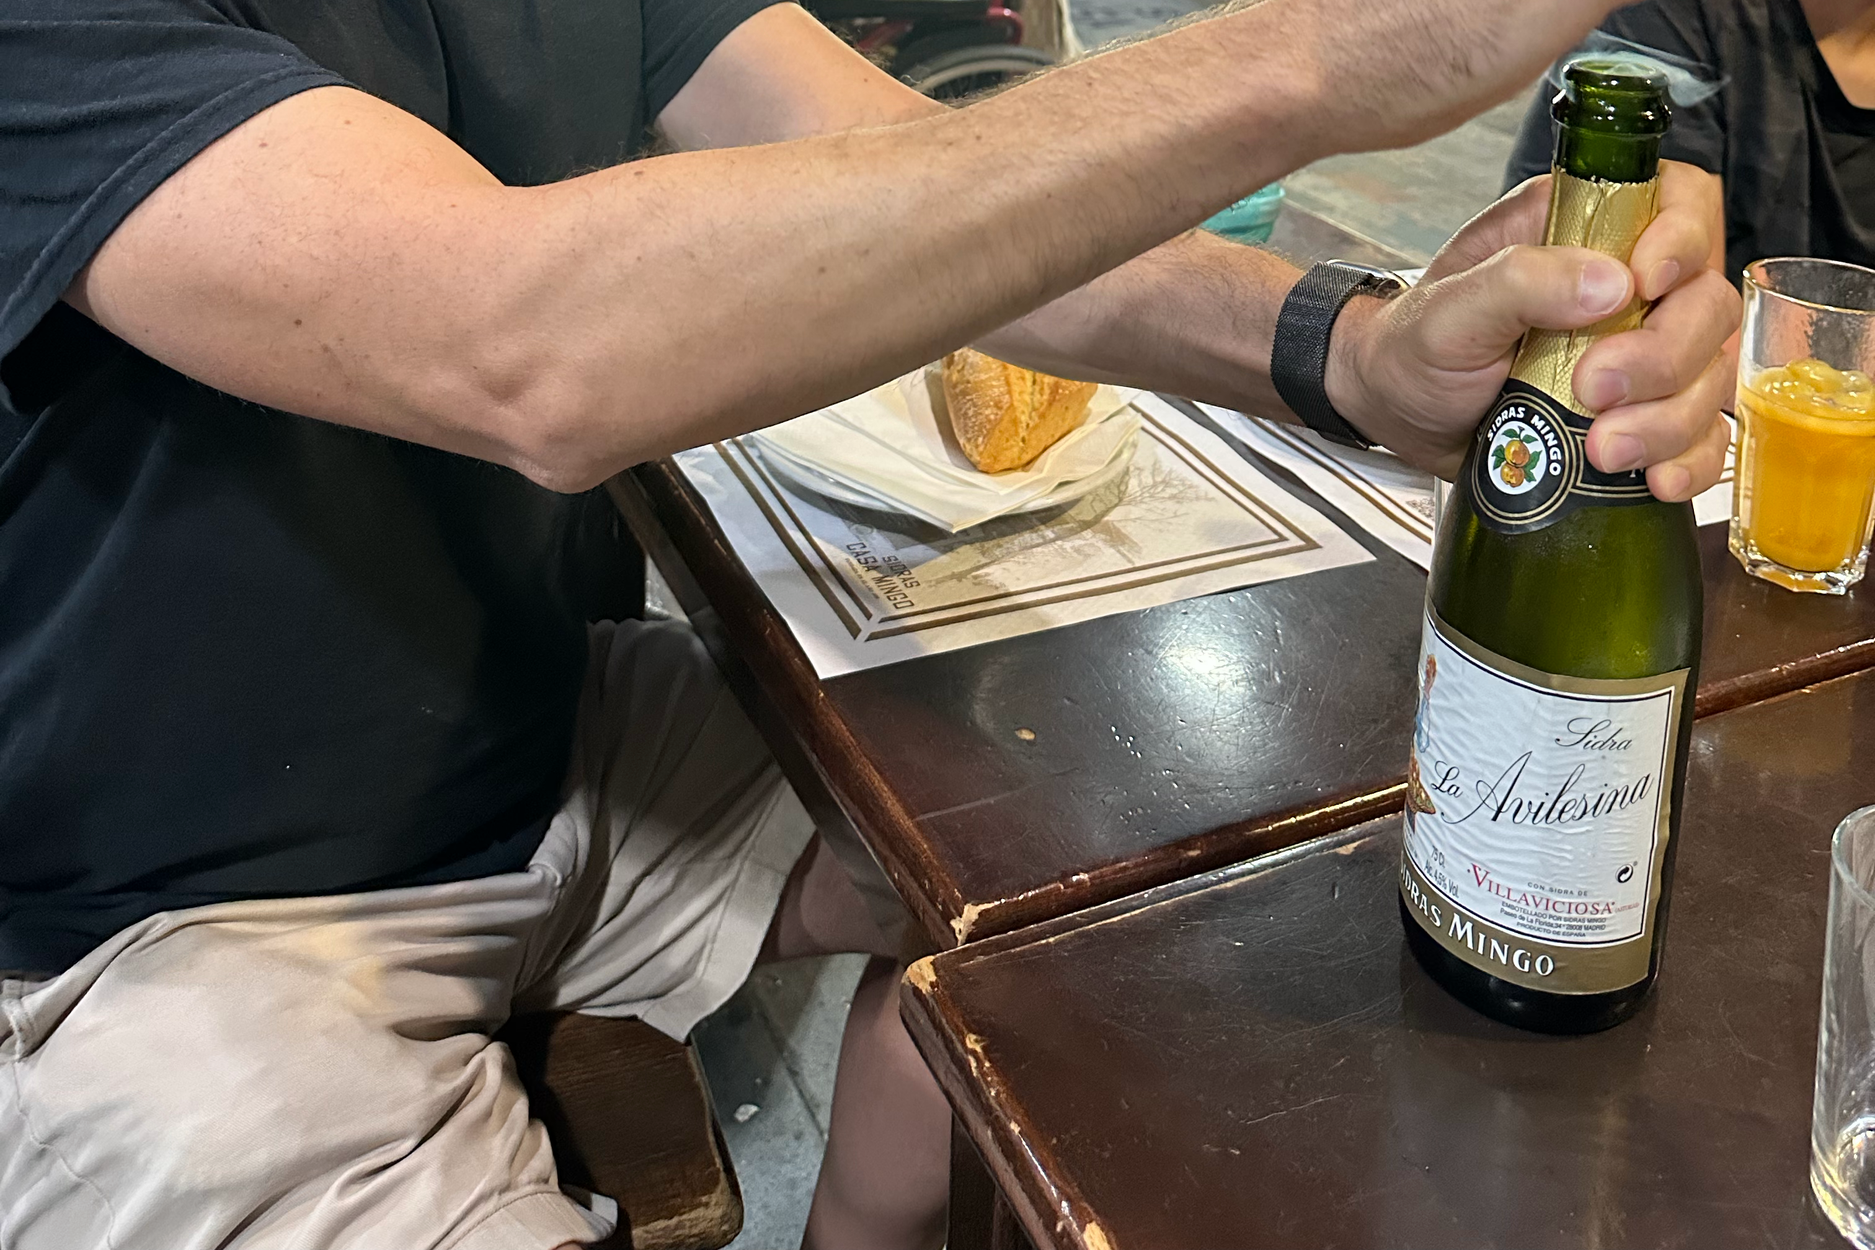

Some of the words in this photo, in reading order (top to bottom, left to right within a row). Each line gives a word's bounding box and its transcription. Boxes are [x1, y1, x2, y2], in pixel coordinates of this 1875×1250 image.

[1487, 406, 1526, 442] SIDRAS
[1530, 414, 1562, 476] MINGO
[846, 542, 882, 573] CASA
[871, 574, 915, 610] MINGO
[882, 555, 921, 589] SIDRAS
[1554, 717, 1633, 751] Sidra
[1431, 760, 1464, 799] La
[1440, 751, 1655, 826] Avilesina
[1527, 881, 1545, 891] CON
[1549, 886, 1574, 896] SIDRA
[1501, 900, 1548, 920] EMBOTELLADO
[1548, 914, 1562, 922] POR
[1516, 921, 1552, 935] PRODUCTO
[1526, 915, 1534, 924] La
[1583, 923, 1607, 931] MADRID
[1448, 912, 1555, 976] MINGO
